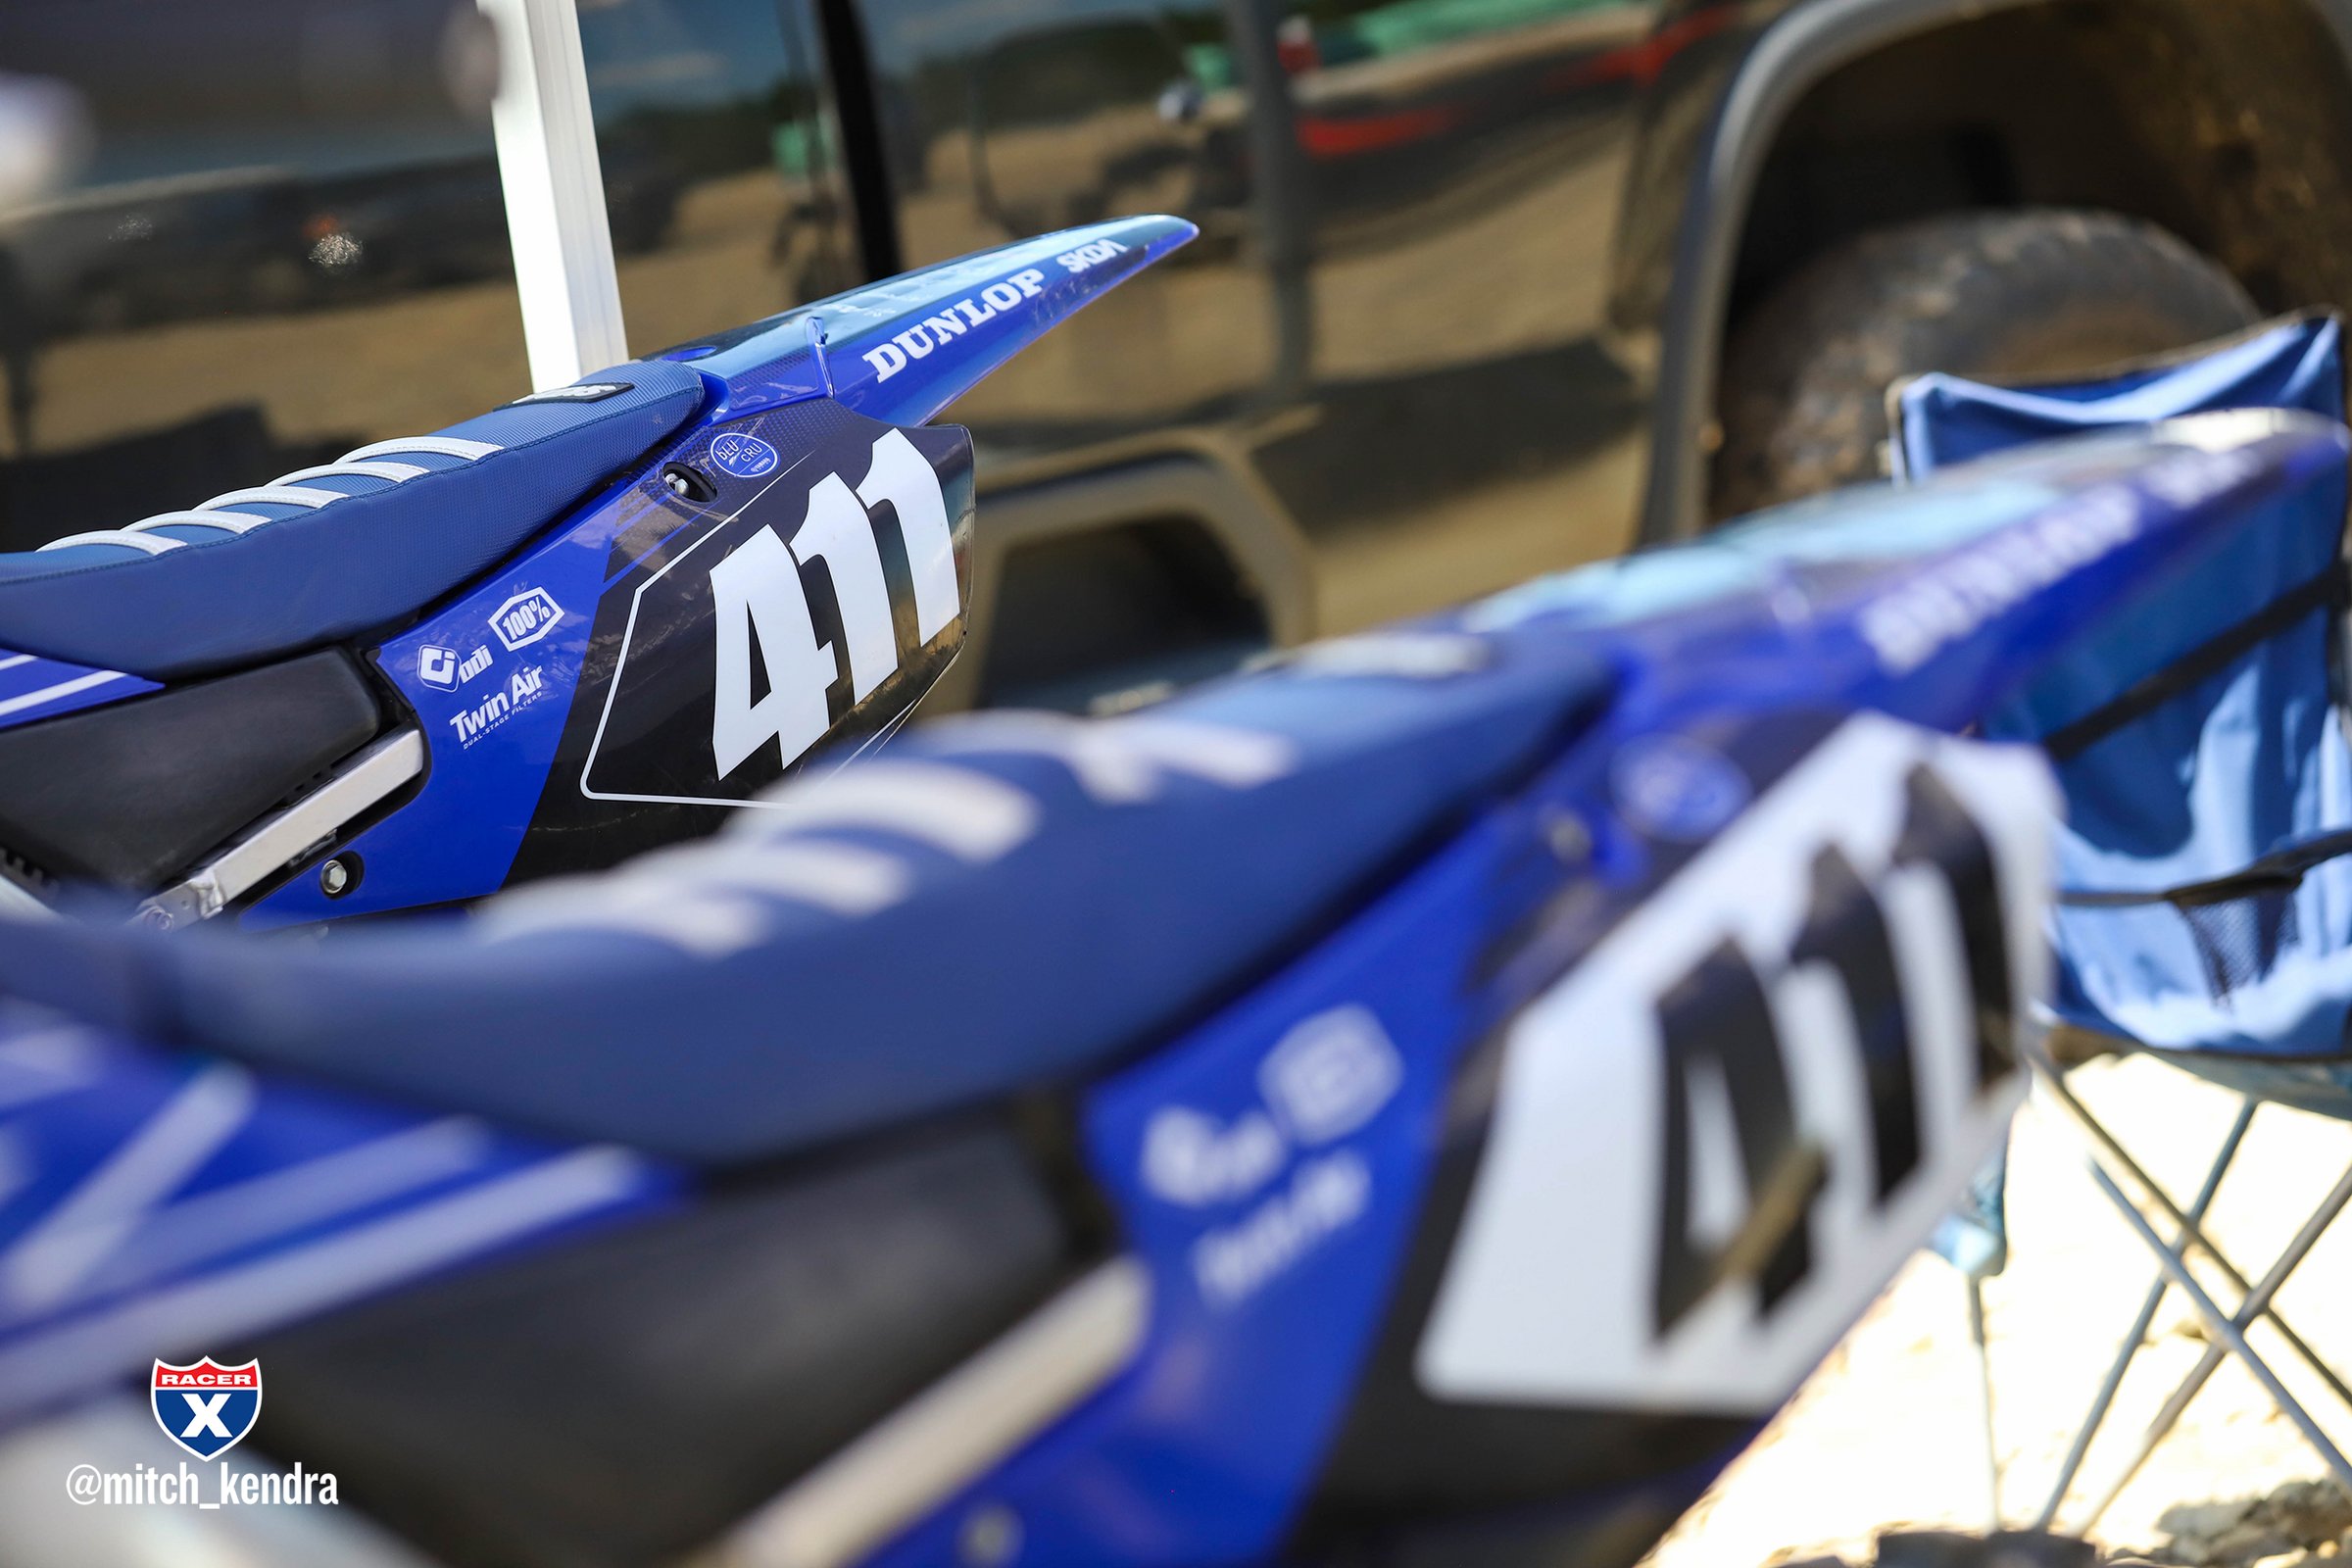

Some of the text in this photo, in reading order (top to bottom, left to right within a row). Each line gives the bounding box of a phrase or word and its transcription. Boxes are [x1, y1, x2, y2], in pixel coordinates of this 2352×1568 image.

[862, 269, 1044, 383] DUNLOP
[502, 597, 551, 640] 100%
[710, 427, 960, 781] 411
[449, 665, 542, 743] Twin Air
[463, 691, 542, 750] DUAL-STAGE FILTERS
[1656, 762, 2015, 1345] 411
